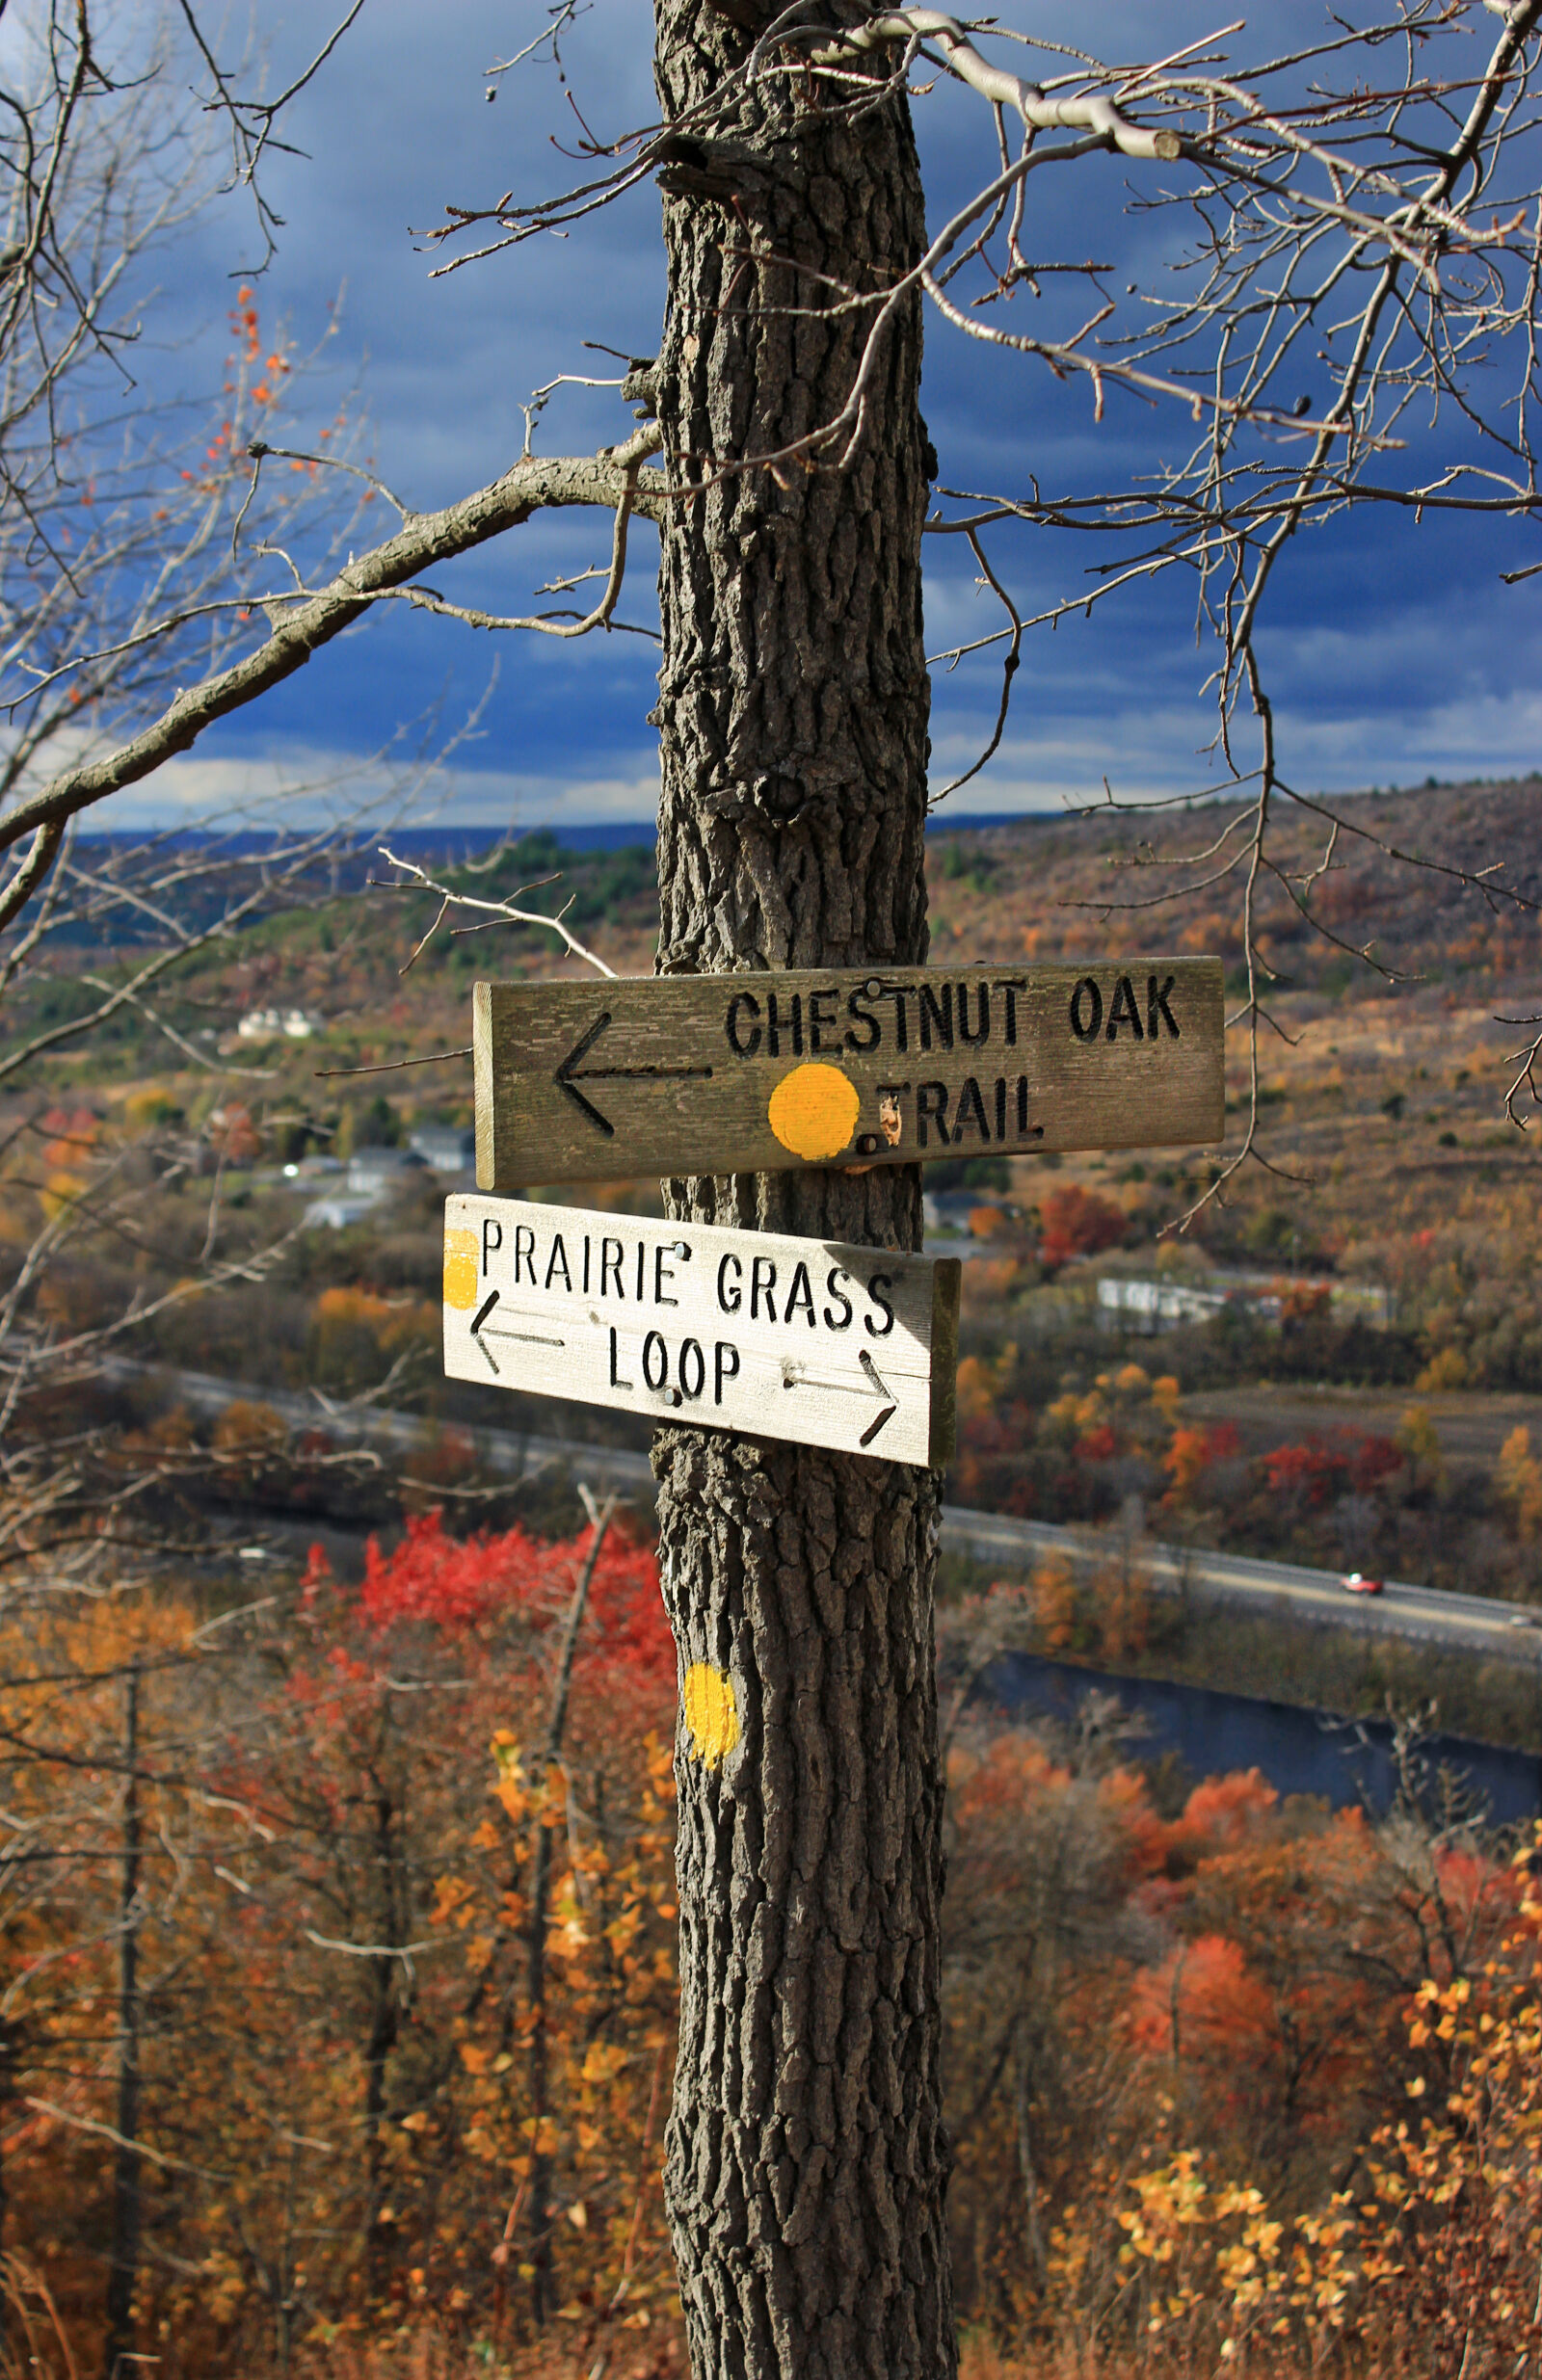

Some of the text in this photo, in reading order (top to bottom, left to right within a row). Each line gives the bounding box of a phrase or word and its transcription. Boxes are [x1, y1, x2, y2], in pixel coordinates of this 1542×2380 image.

[725, 975, 1181, 1058] CHESTNUT OAK
[482, 1219, 895, 1338] PRAIRIE GRASS
[609, 1327, 740, 1405] LOOP
